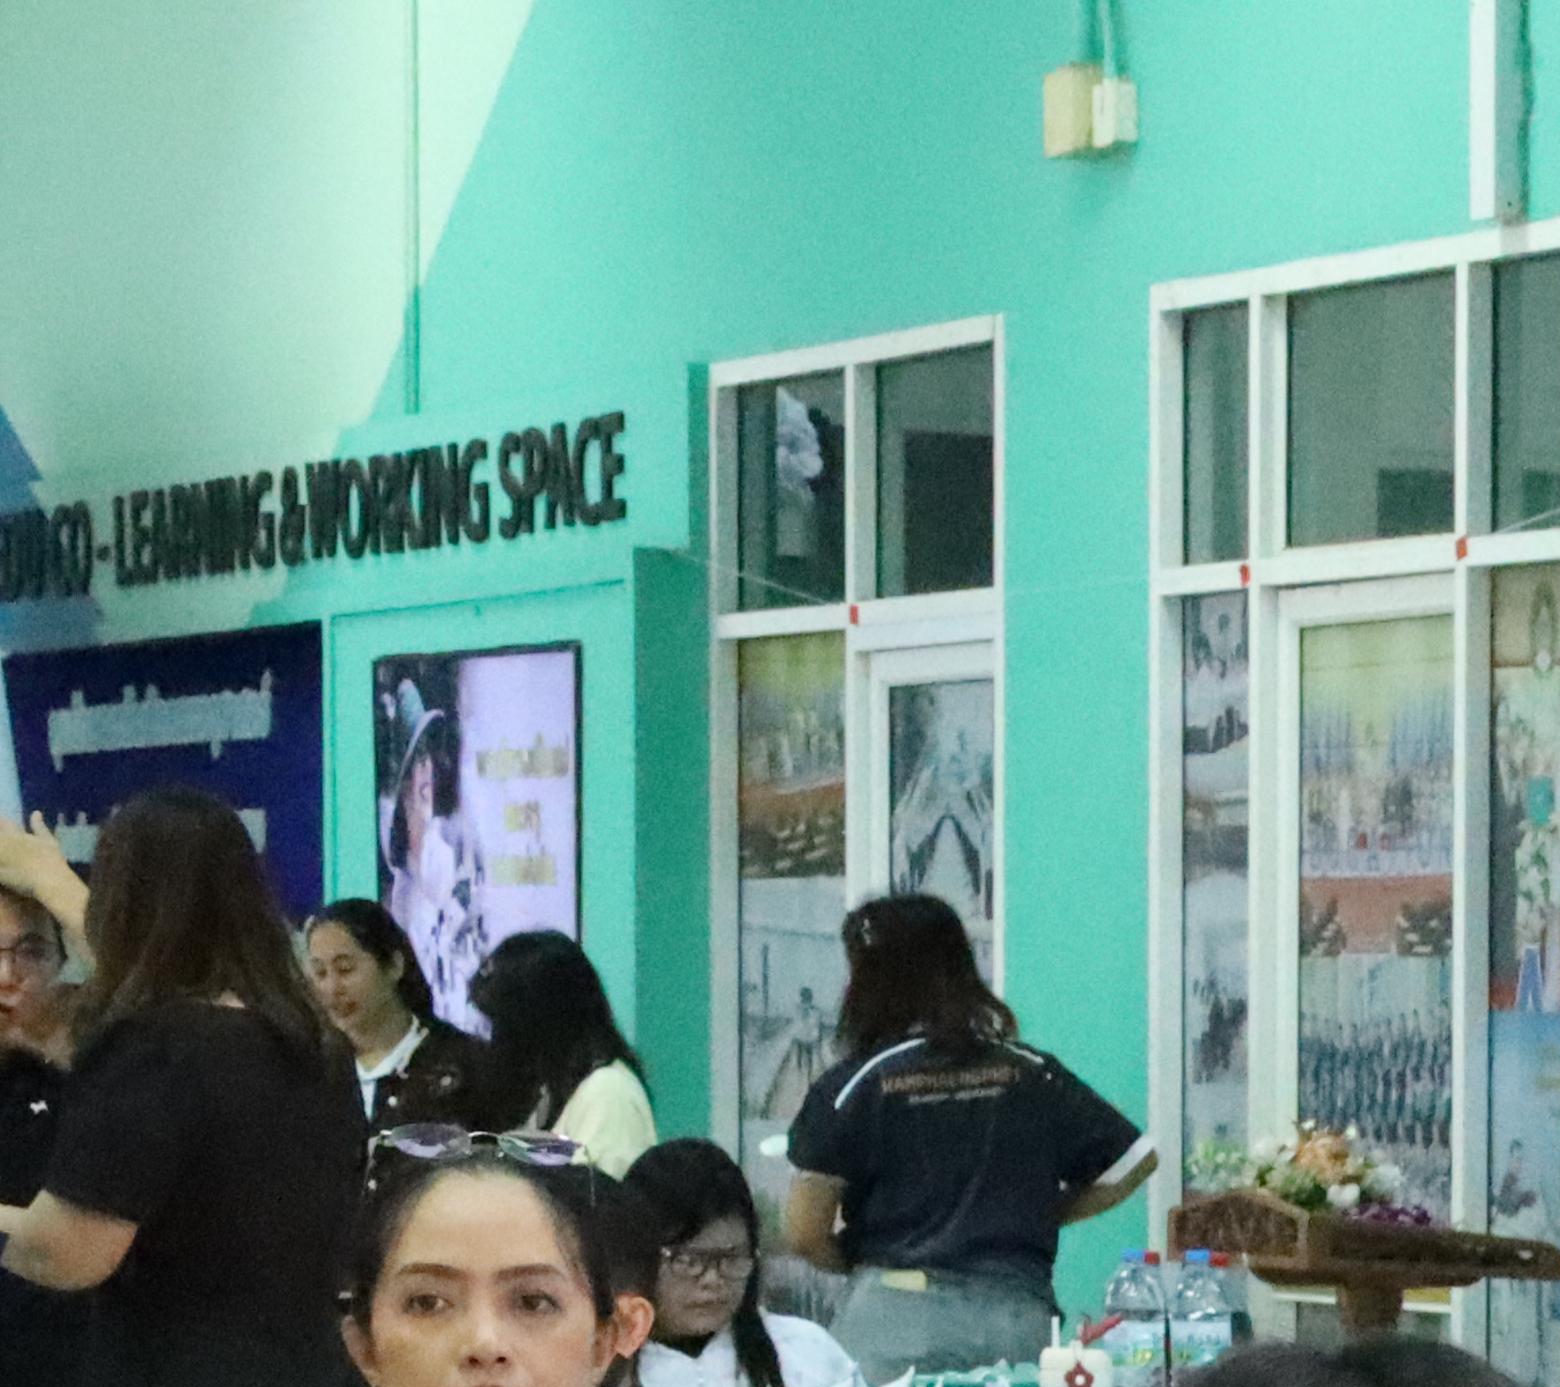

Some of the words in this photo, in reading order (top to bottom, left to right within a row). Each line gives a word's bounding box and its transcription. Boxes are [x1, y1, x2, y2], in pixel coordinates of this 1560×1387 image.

[113, 468, 276, 587] LEARNING
[305, 439, 490, 560] WORKING
[499, 411, 627, 540] SPACE
